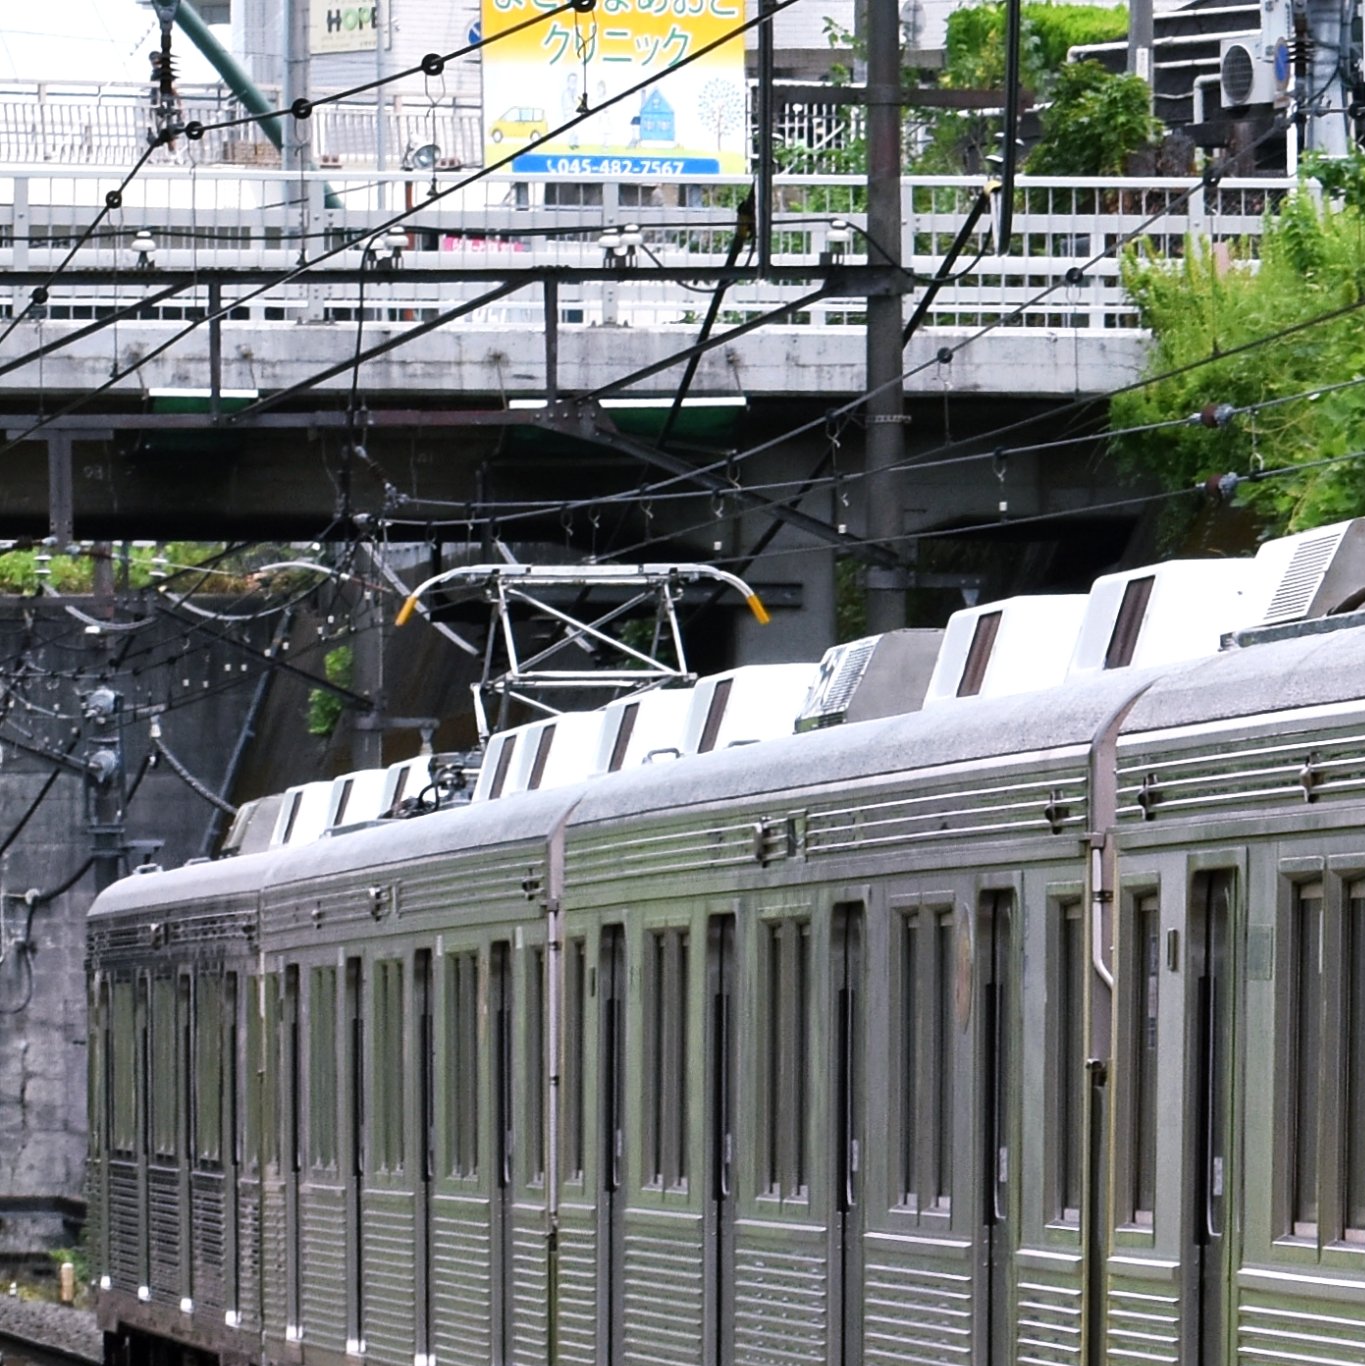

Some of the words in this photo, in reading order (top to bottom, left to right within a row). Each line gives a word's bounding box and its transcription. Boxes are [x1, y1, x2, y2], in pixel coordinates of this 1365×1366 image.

[544, 23, 690, 67] クリニック
[557, 158, 685, 175] 045-482-7567
